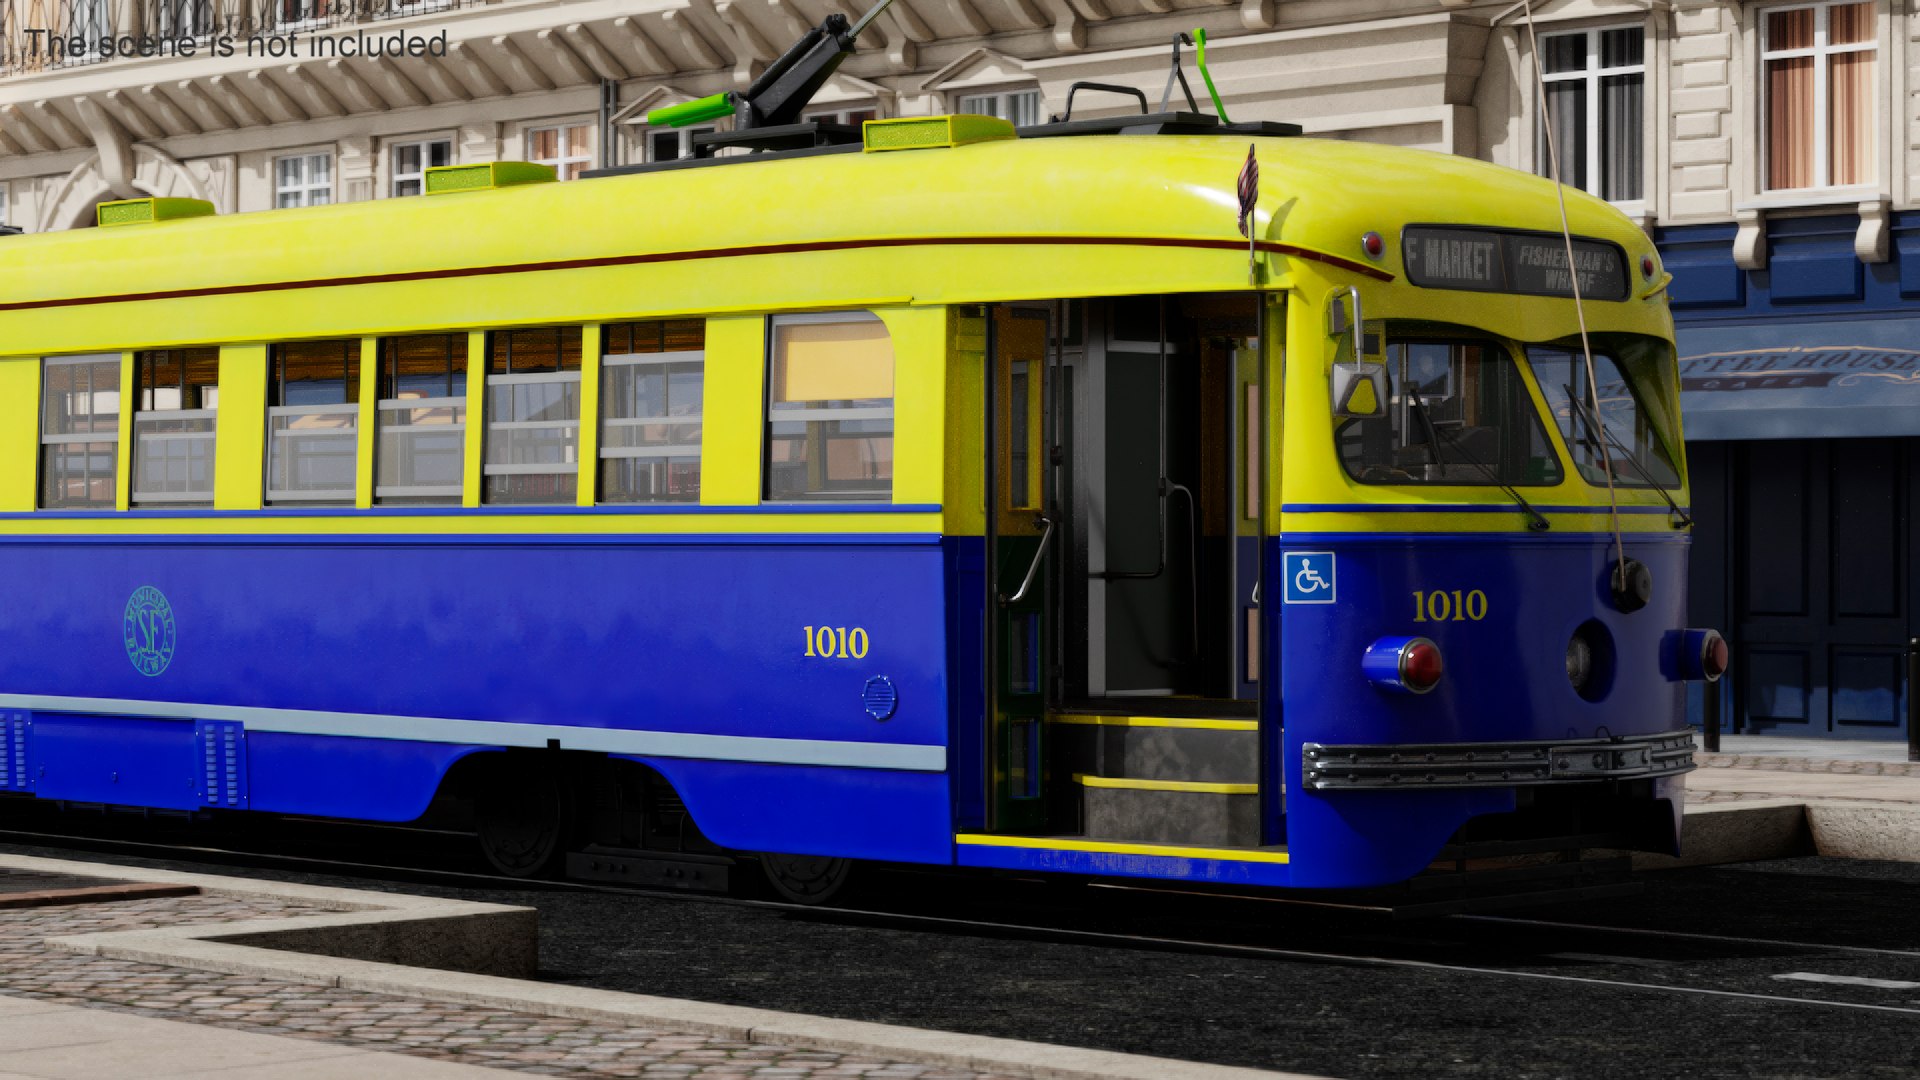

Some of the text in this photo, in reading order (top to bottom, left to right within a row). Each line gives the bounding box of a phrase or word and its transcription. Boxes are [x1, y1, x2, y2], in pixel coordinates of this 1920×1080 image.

[1405, 237, 1494, 281] F MARKET
[1519, 245, 1615, 273] FISHERMAN'S
[1788, 351, 1920, 371] HOUSE
[1412, 590, 1489, 622] 1010
[803, 625, 869, 659] 1010
